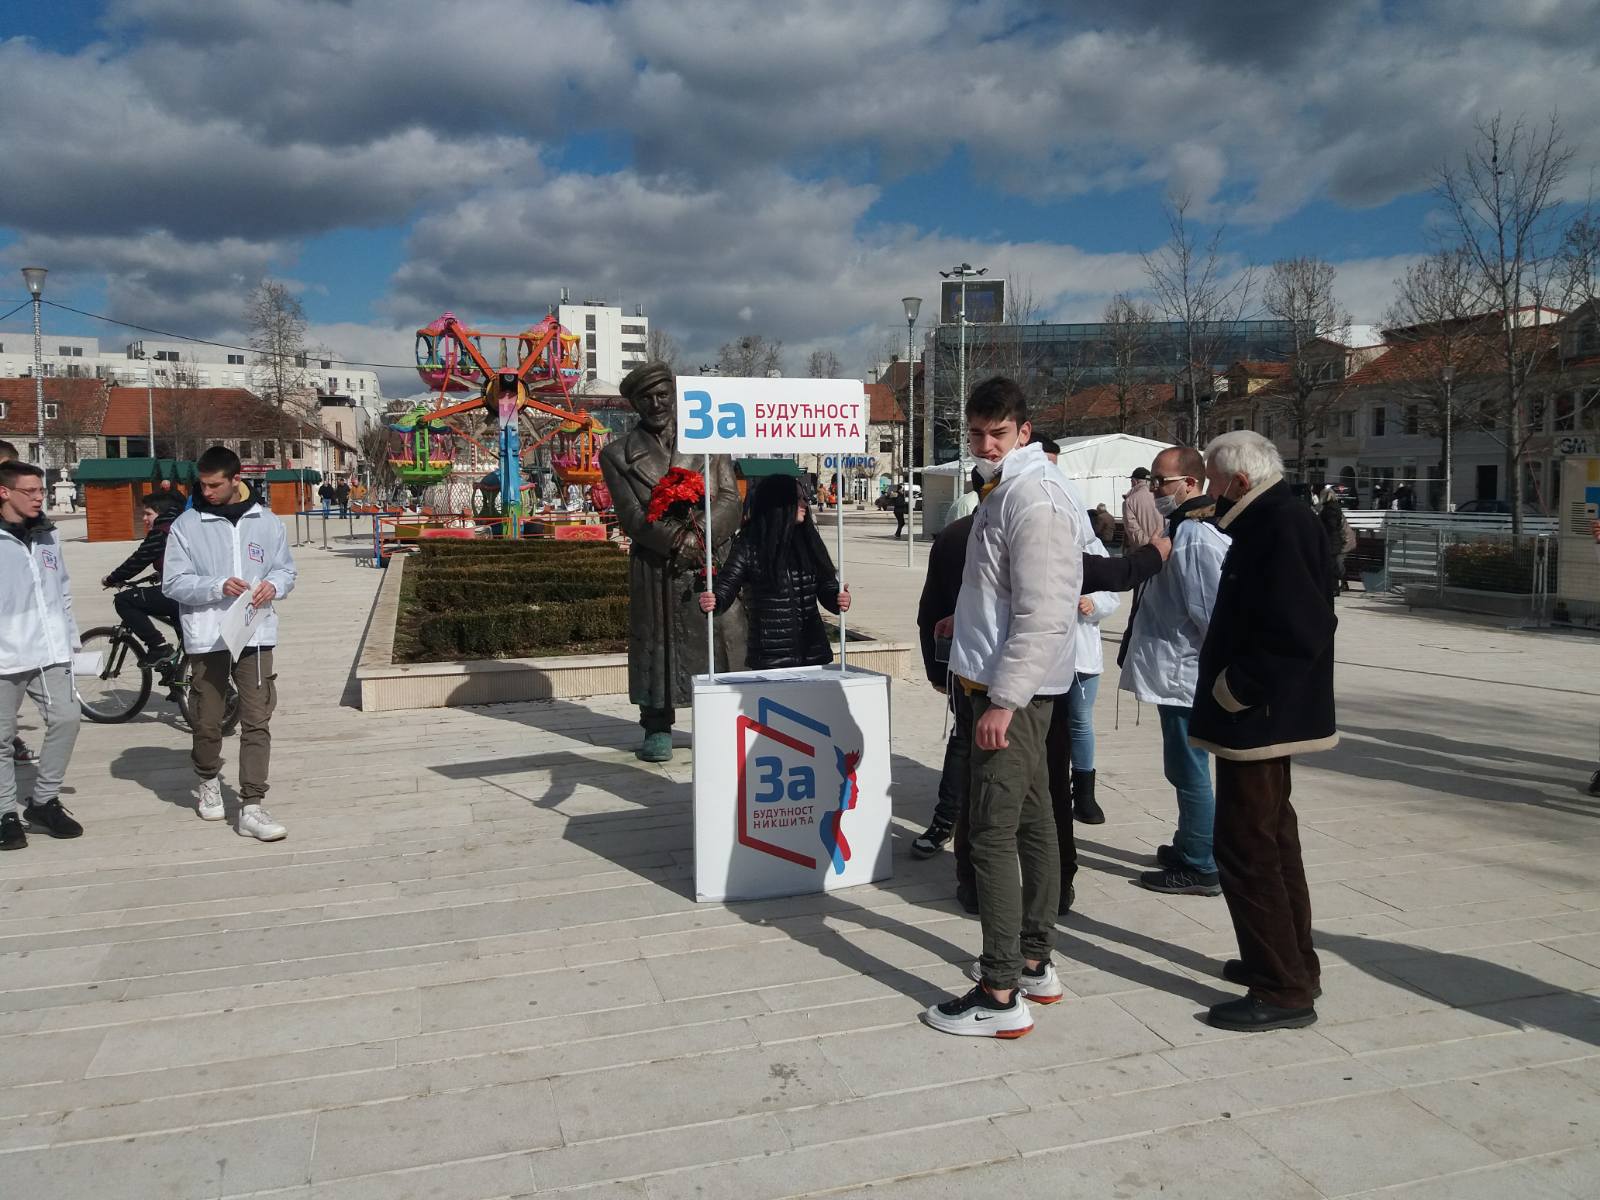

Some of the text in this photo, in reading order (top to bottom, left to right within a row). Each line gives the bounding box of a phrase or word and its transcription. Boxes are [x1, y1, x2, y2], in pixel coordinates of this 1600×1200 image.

[683, 390, 746, 439] За
[755, 403, 860, 421] БУДУЋНОСТ
[755, 422, 860, 438] НИКШИЋА
[824, 456, 876, 469] OLYMPIC
[755, 756, 816, 803] За
[753, 806, 814, 819] БУДУЋНОСТ
[753, 816, 814, 829] НИКШИЋА
